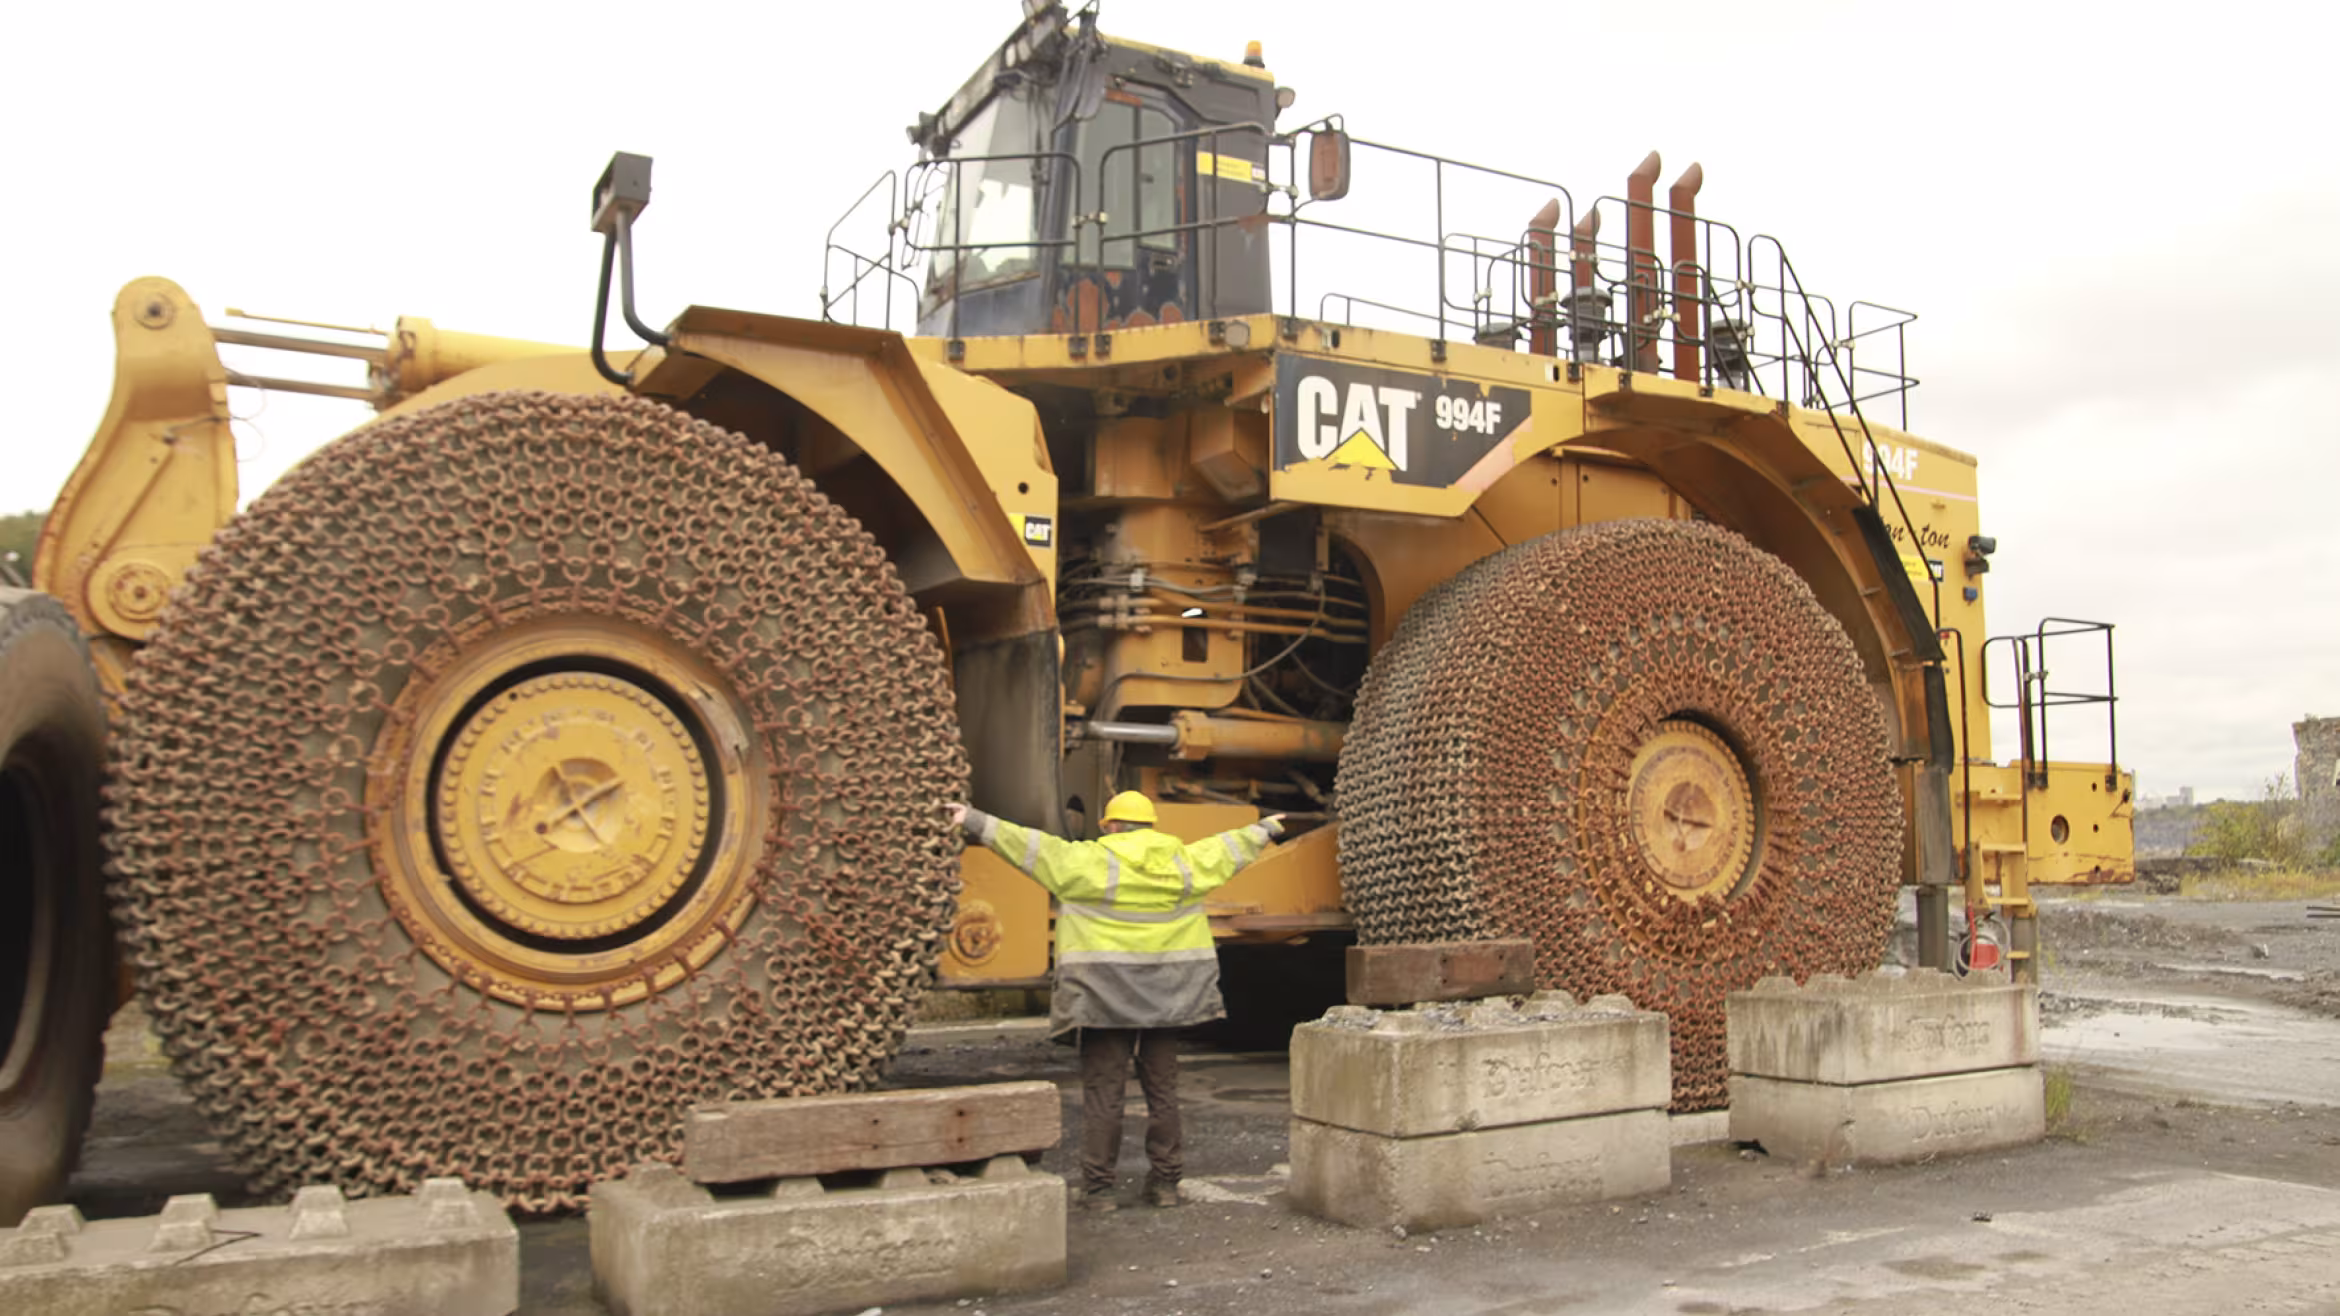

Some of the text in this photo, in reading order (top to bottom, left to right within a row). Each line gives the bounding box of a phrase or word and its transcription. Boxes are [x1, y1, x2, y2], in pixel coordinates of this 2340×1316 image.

[1297, 375, 1502, 472] CAT 994F
[1025, 522, 1051, 541] CAT
